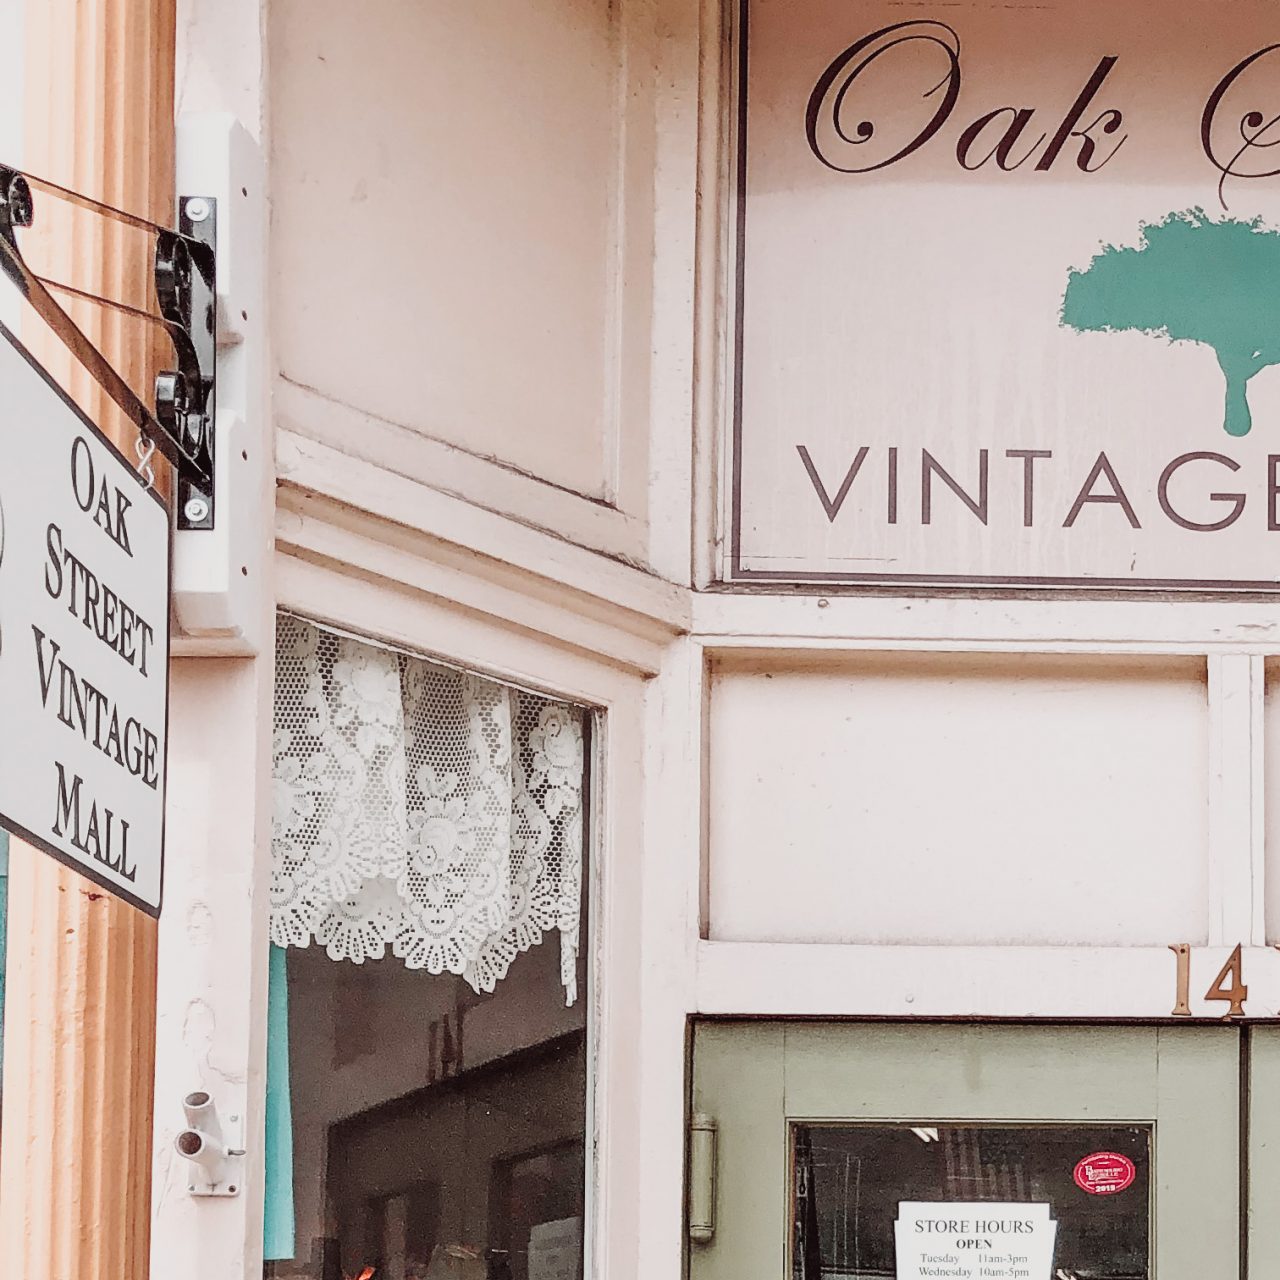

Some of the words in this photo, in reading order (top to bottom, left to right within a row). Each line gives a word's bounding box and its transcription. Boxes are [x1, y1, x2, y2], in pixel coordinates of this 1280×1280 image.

[804, 19, 1128, 174] Oak
[70, 436, 133, 557] OAK
[45, 523, 153, 678] STREET
[32, 623, 159, 791] VINTAGE
[51, 761, 137, 883] MALL
[914, 1219, 970, 1234] STORE
[975, 1219, 1034, 1234] HOURS
[919, 1267, 972, 1278] Wednesday
[979, 1267, 1030, 1278] 10am-5pm
[920, 1253, 960, 1264] Tuesday
[978, 1253, 1028, 1264] 11am-3pm
[956, 1239, 993, 1249] OPEN
